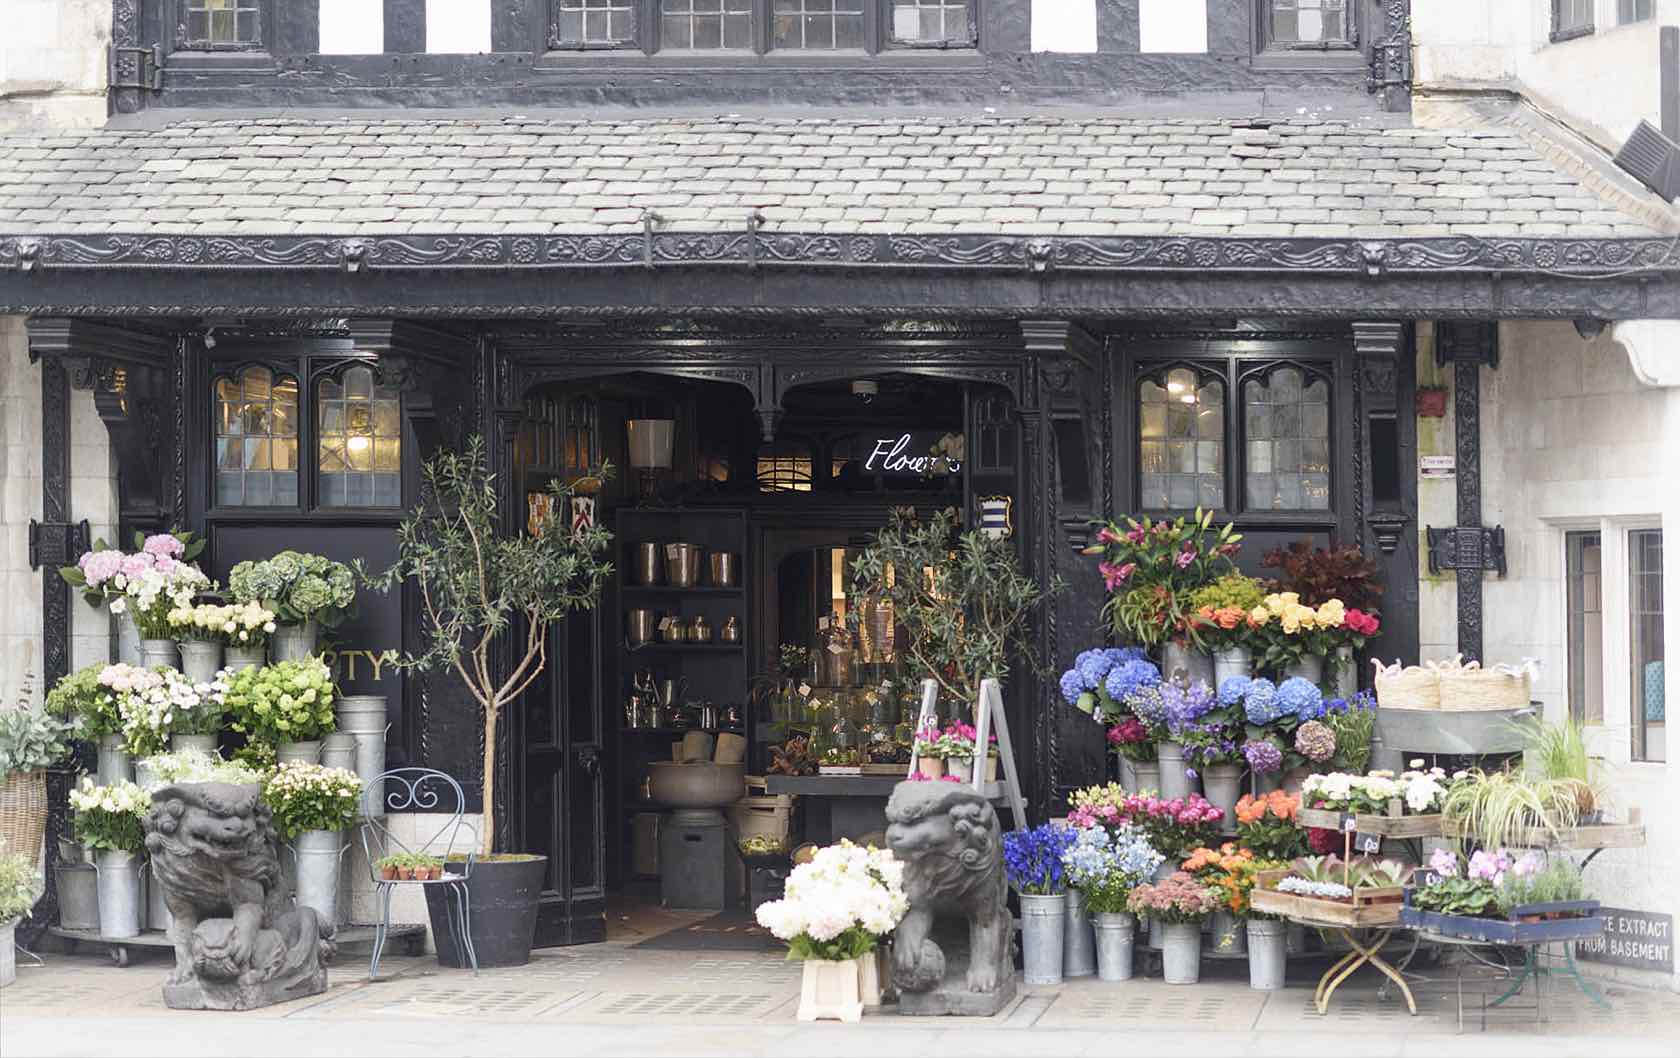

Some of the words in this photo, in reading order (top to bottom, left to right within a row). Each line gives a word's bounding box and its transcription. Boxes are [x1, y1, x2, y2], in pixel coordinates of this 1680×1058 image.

[865, 433, 960, 472] Flows
[1619, 917, 1669, 937] EXTRACT
[1610, 940, 1670, 961] BASEMENT
